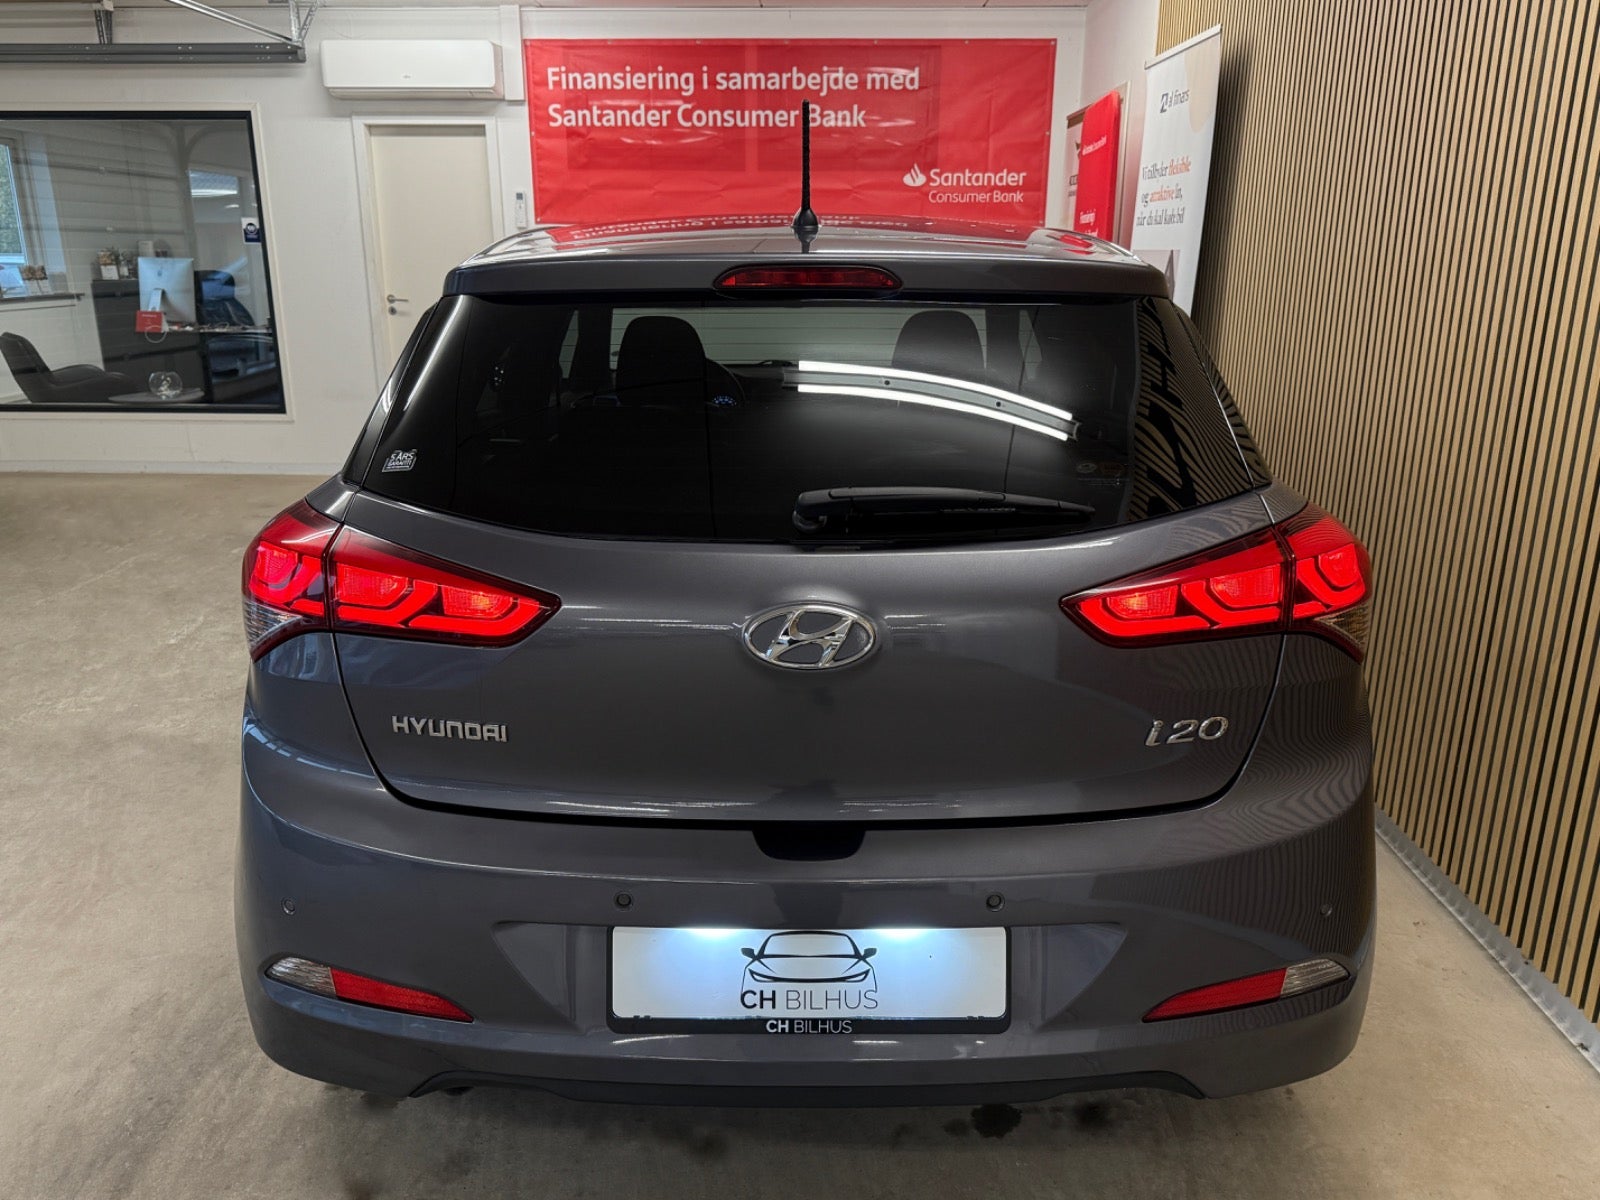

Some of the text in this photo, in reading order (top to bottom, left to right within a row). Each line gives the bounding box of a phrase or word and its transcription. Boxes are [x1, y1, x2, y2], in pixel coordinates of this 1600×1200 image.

[547, 65, 920, 97] Finansiering i samarbejde med
[548, 103, 867, 128] Santander Consumer Bank
[929, 168, 1027, 187] Santander
[928, 190, 1024, 204] Consumer Bank
[391, 715, 508, 742] HYUNDAI
[740, 989, 879, 1010] CH BILHUS
[766, 1020, 853, 1034] CH BILHUS
